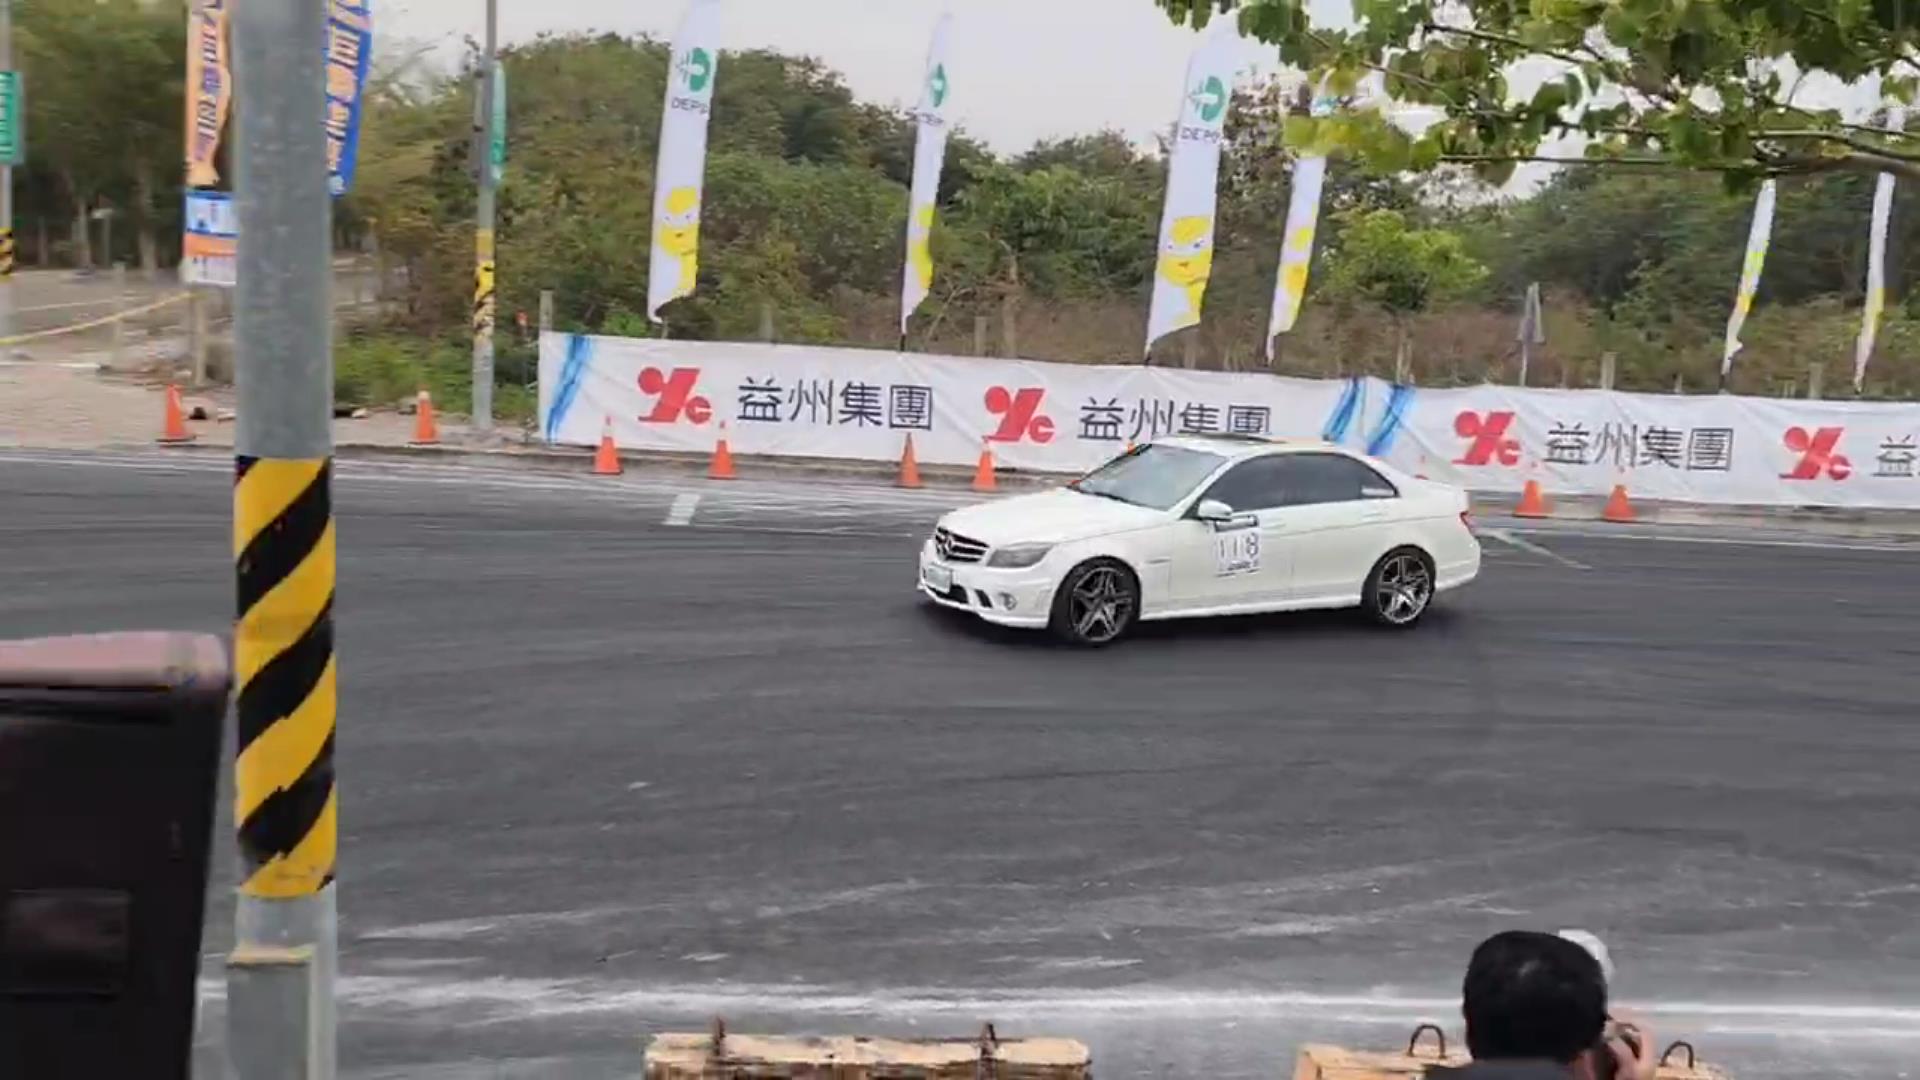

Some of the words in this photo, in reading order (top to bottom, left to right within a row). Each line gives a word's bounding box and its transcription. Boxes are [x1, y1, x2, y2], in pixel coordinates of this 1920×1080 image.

[737, 376, 932, 430] 益州集團
[1544, 421, 1734, 471] 益州集團
